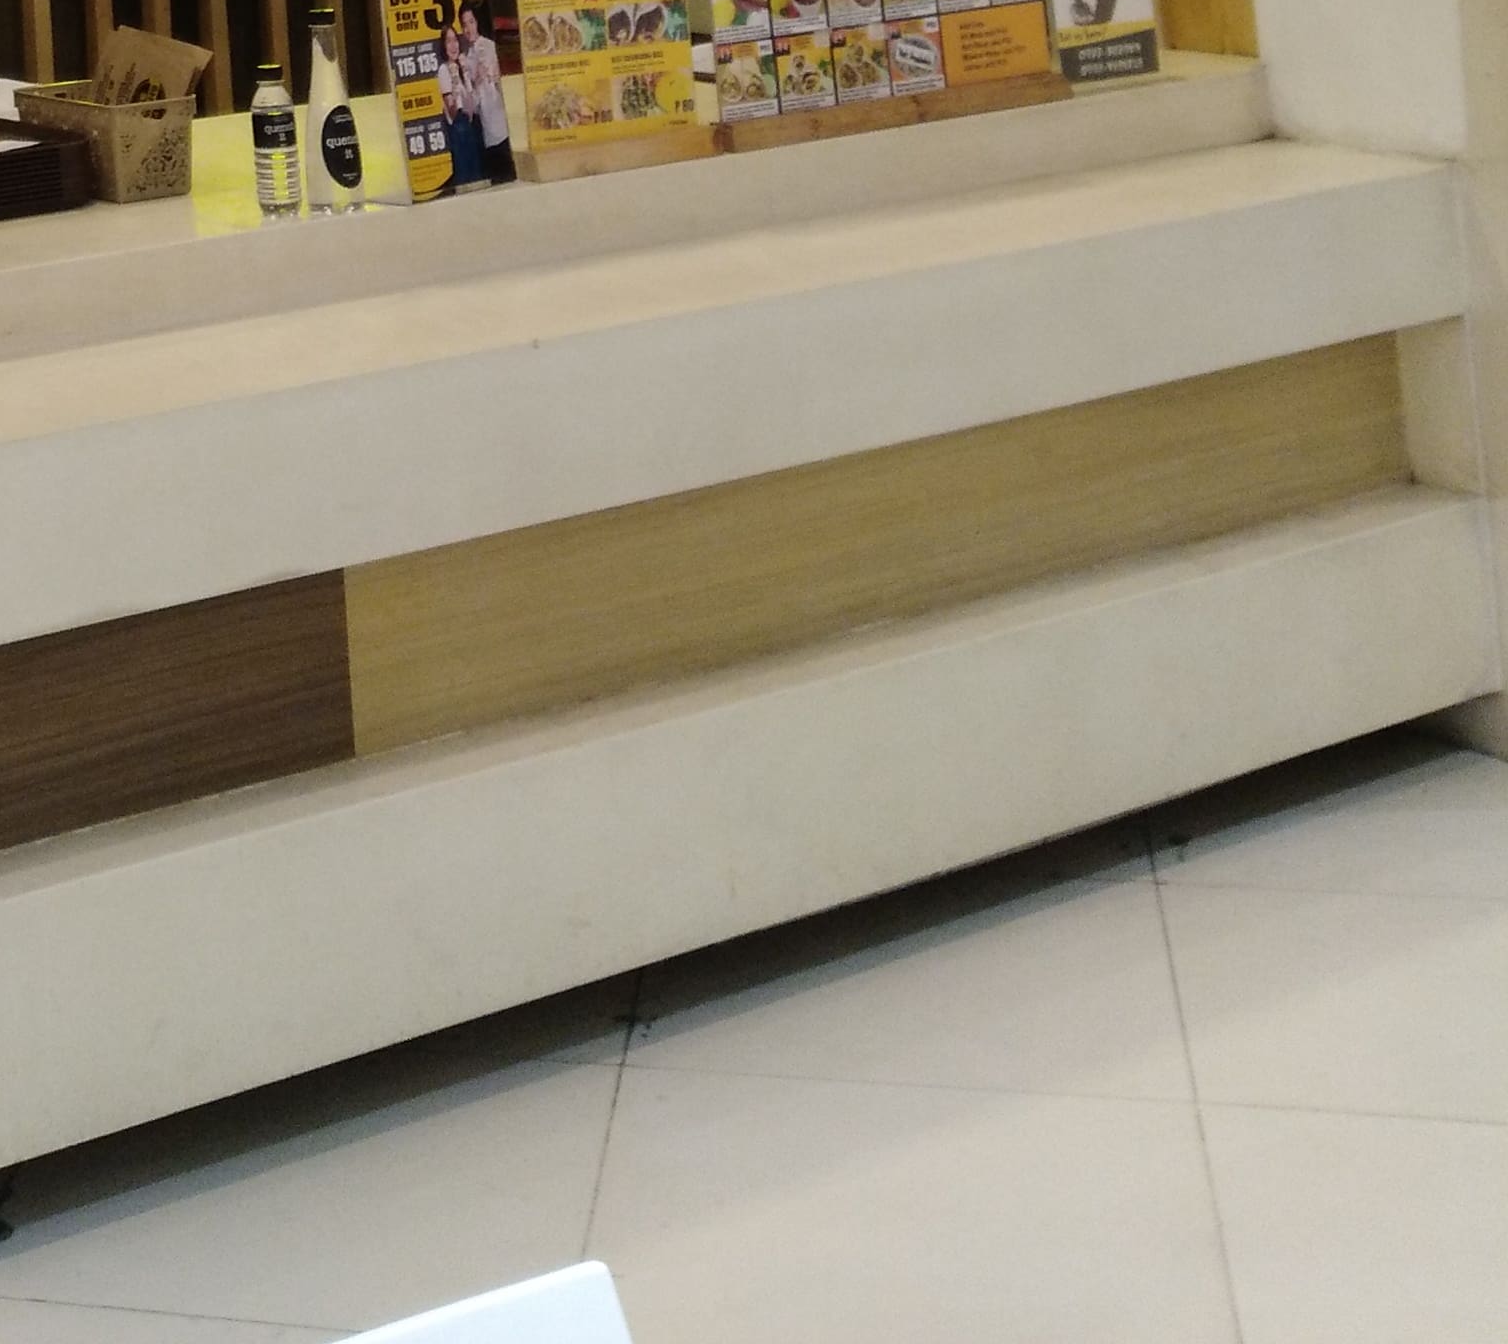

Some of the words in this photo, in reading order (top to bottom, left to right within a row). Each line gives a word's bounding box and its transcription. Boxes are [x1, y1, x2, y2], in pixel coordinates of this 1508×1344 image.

[395, 11, 418, 22] for
[397, 57, 416, 77] 115
[417, 53, 438, 74] 135
[409, 135, 425, 155] 49
[429, 131, 445, 151] 59
